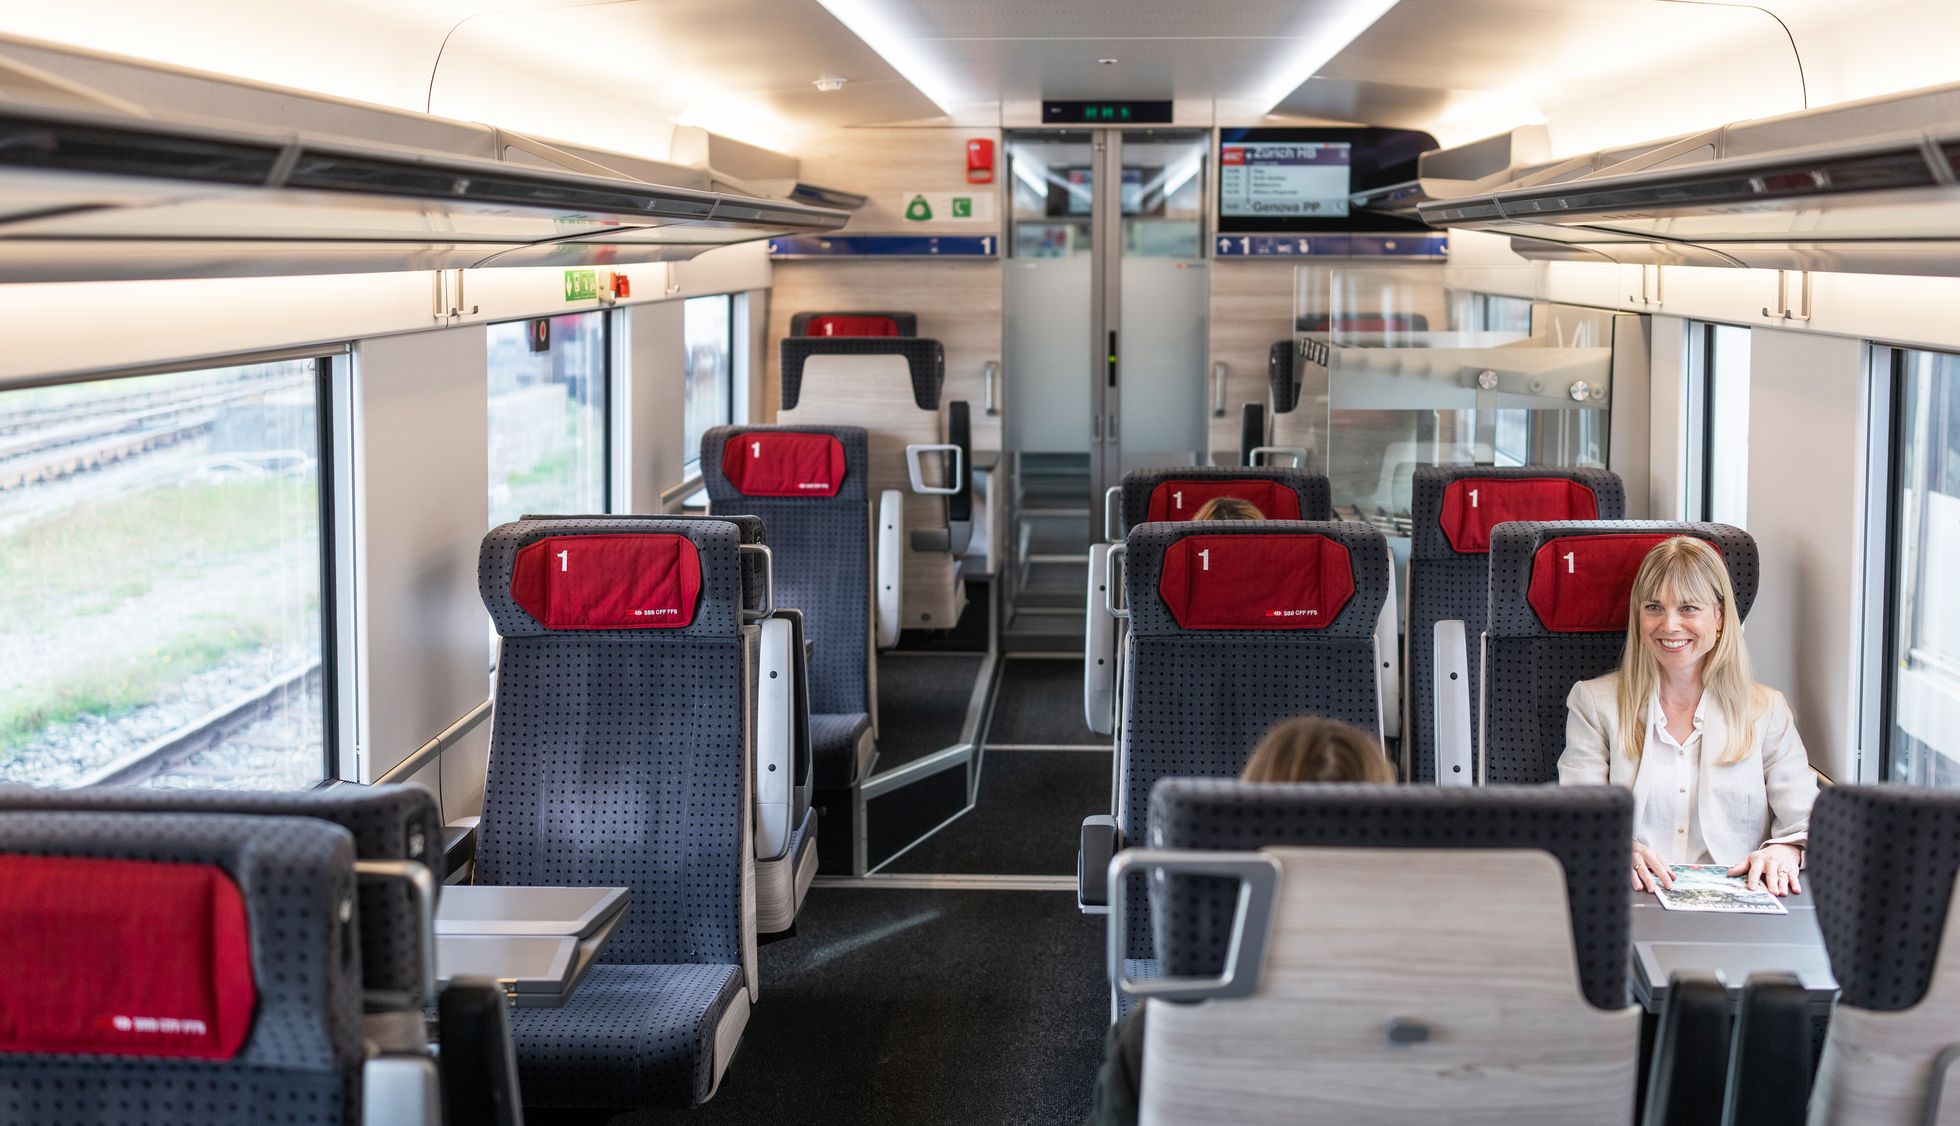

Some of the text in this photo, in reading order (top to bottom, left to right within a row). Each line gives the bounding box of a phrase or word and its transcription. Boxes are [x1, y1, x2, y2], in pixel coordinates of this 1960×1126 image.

[981, 237, 992, 255] 1
[1239, 237, 1250, 256] 1
[825, 323, 833, 336] 1
[751, 442, 760, 458] 1
[1173, 491, 1182, 509] 1
[1469, 489, 1478, 508] 1
[557, 550, 568, 572] 1
[1198, 549, 1209, 571] 1
[1563, 552, 1574, 574] 1
